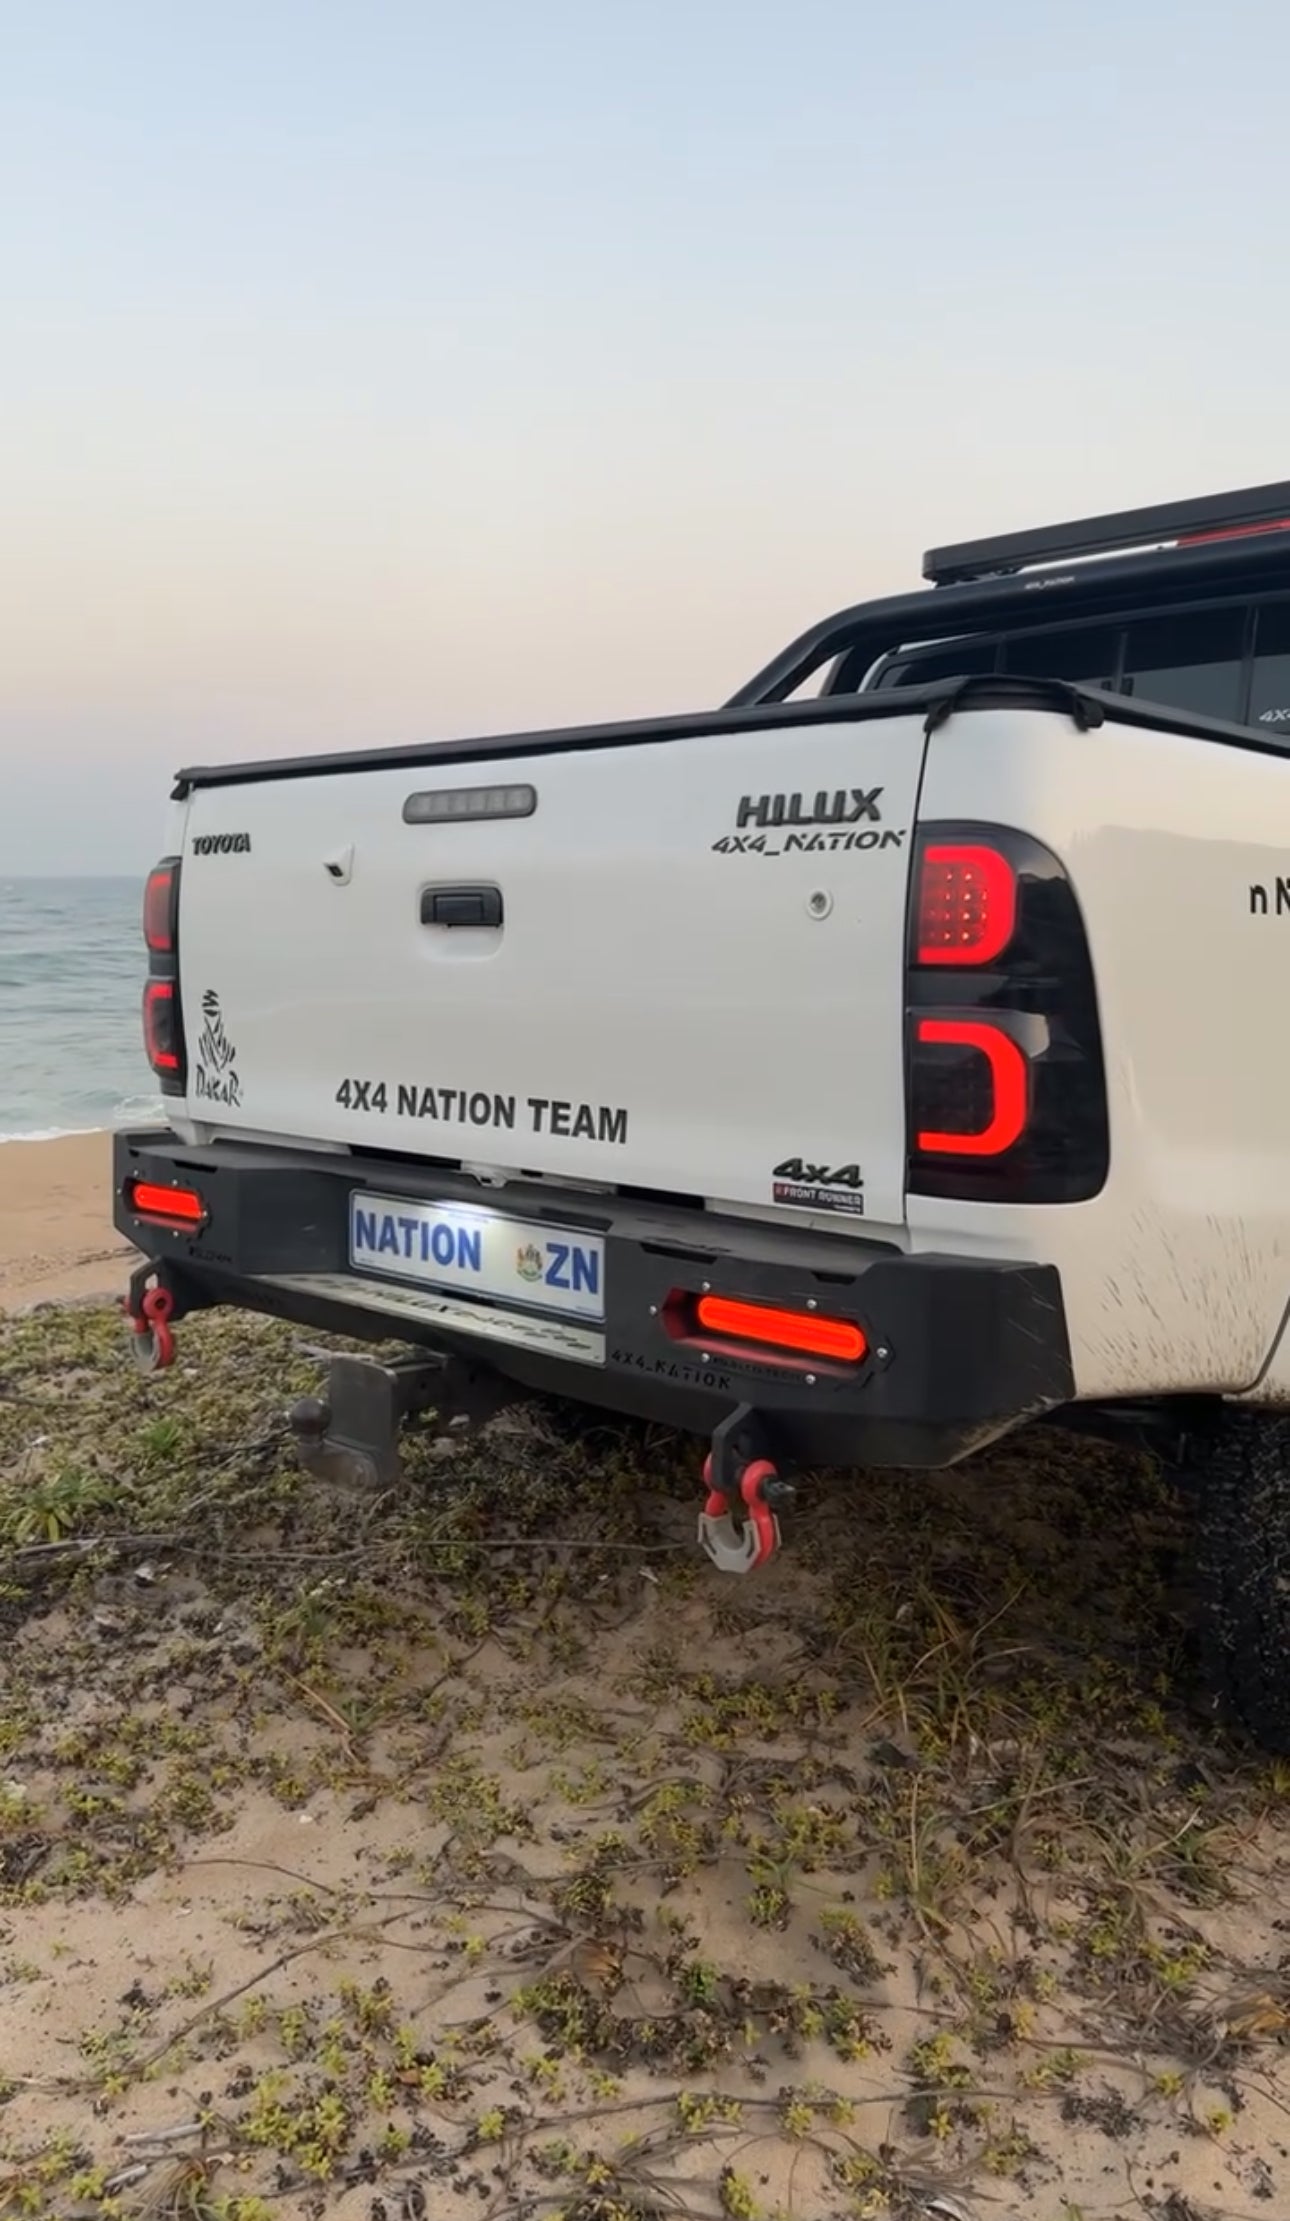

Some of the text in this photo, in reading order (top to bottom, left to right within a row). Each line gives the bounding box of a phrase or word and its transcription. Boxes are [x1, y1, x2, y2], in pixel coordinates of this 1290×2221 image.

[736, 787, 884, 828] HILUX
[192, 832, 252, 856] TOYOTA
[711, 829, 906, 856] 4X4_NATION
[196, 1063, 241, 1107] DAKAR
[336, 1079, 628, 1144] 4X4 NATION TEAM
[772, 1157, 864, 1189] 4x4
[784, 1186, 817, 1200] FRONT
[356, 1209, 599, 1295] NATION ZN
